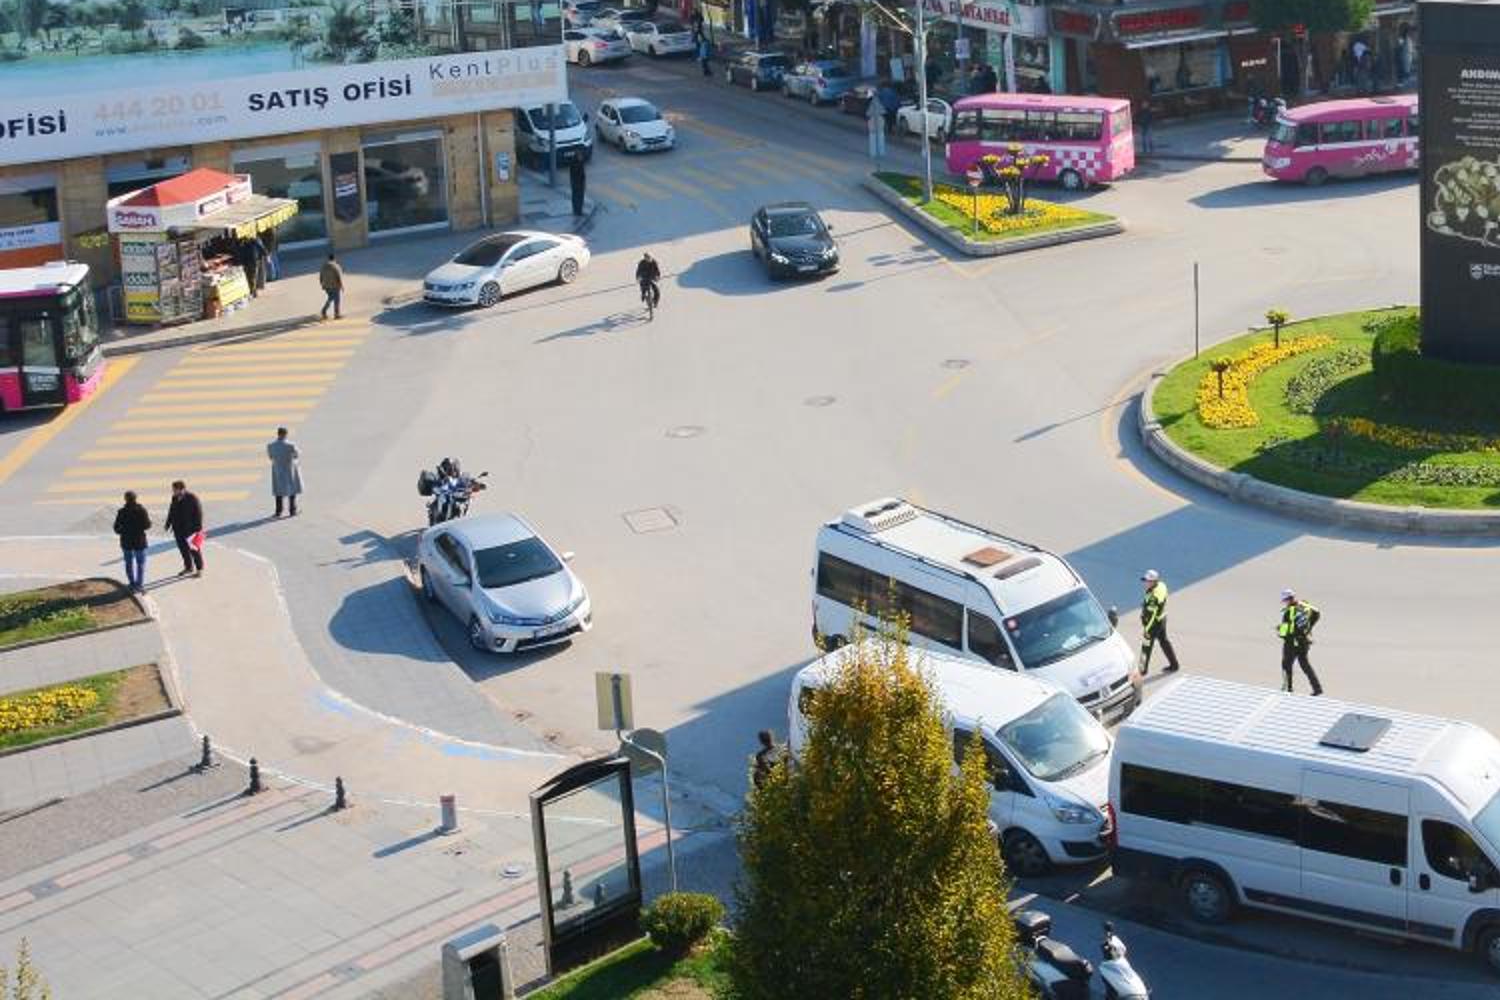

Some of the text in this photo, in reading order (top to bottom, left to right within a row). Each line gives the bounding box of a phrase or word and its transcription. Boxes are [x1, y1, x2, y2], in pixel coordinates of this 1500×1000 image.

[150, 94, 185, 117] 20
[247, 86, 329, 111] SATIŞ
[343, 74, 412, 101] OFİSİ
